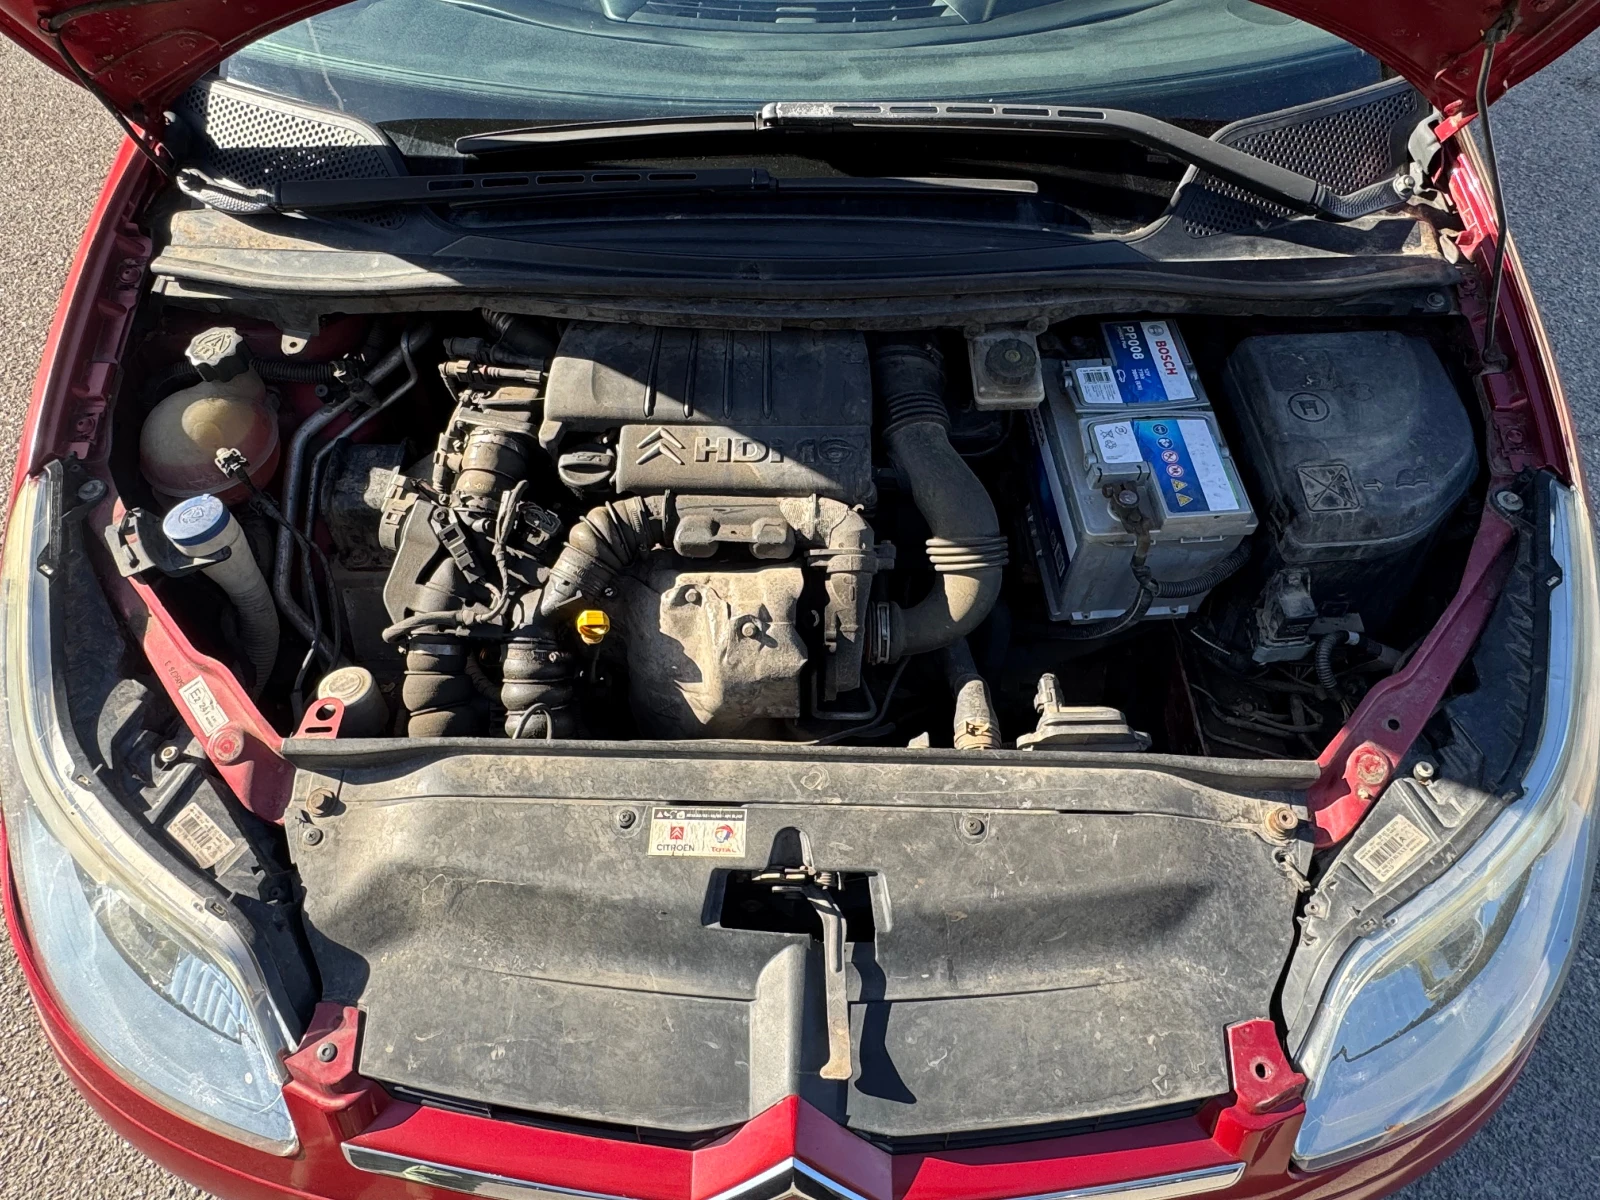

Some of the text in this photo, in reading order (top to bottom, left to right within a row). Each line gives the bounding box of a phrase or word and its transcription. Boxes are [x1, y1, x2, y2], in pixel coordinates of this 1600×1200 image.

[1122, 325, 1145, 360] PP008
[1155, 340, 1179, 375] BOSCH
[656, 842, 695, 852] CITROËN
